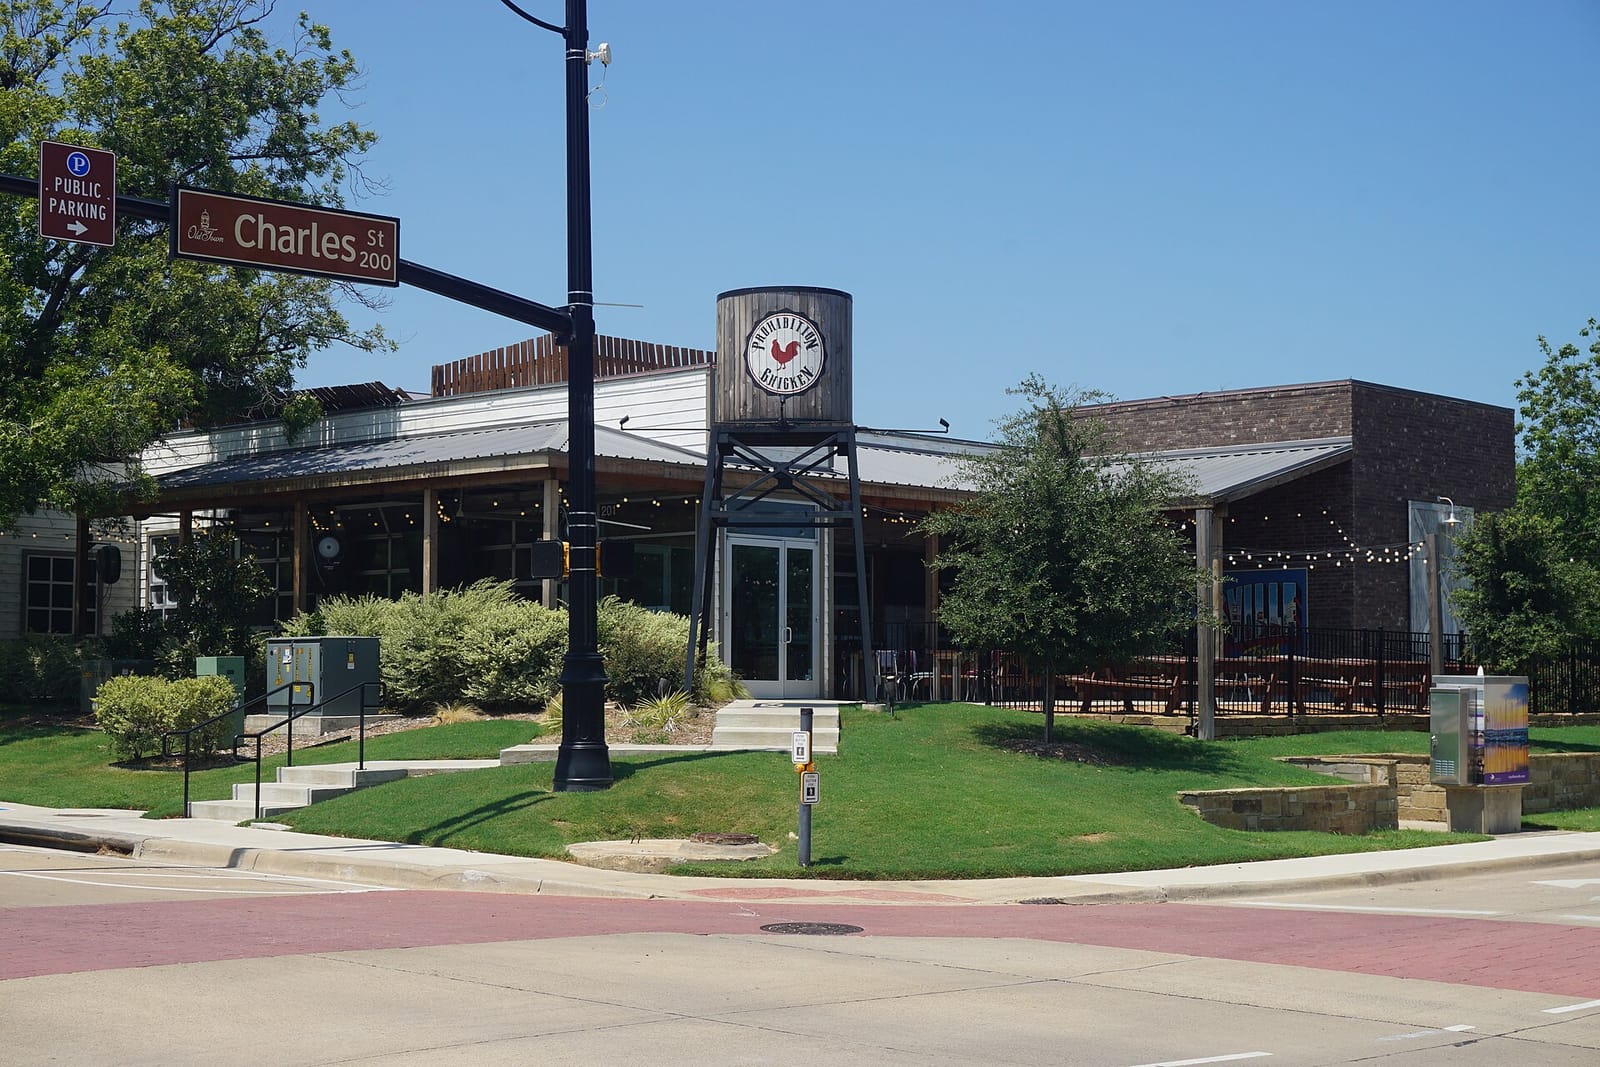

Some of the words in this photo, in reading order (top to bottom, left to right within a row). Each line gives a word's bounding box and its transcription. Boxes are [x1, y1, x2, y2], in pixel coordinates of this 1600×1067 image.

[73, 156, 87, 172] P
[55, 176, 101, 199] PUBLIC
[49, 198, 106, 221] PARKING
[187, 224, 203, 240] Old
[198, 227, 225, 243] Town
[234, 213, 357, 263] Charles
[367, 229, 385, 248] St
[359, 251, 392, 271] 200
[752, 317, 819, 350] PROHIBITION
[760, 365, 815, 390] CHICKEN
[601, 504, 616, 516] 201
